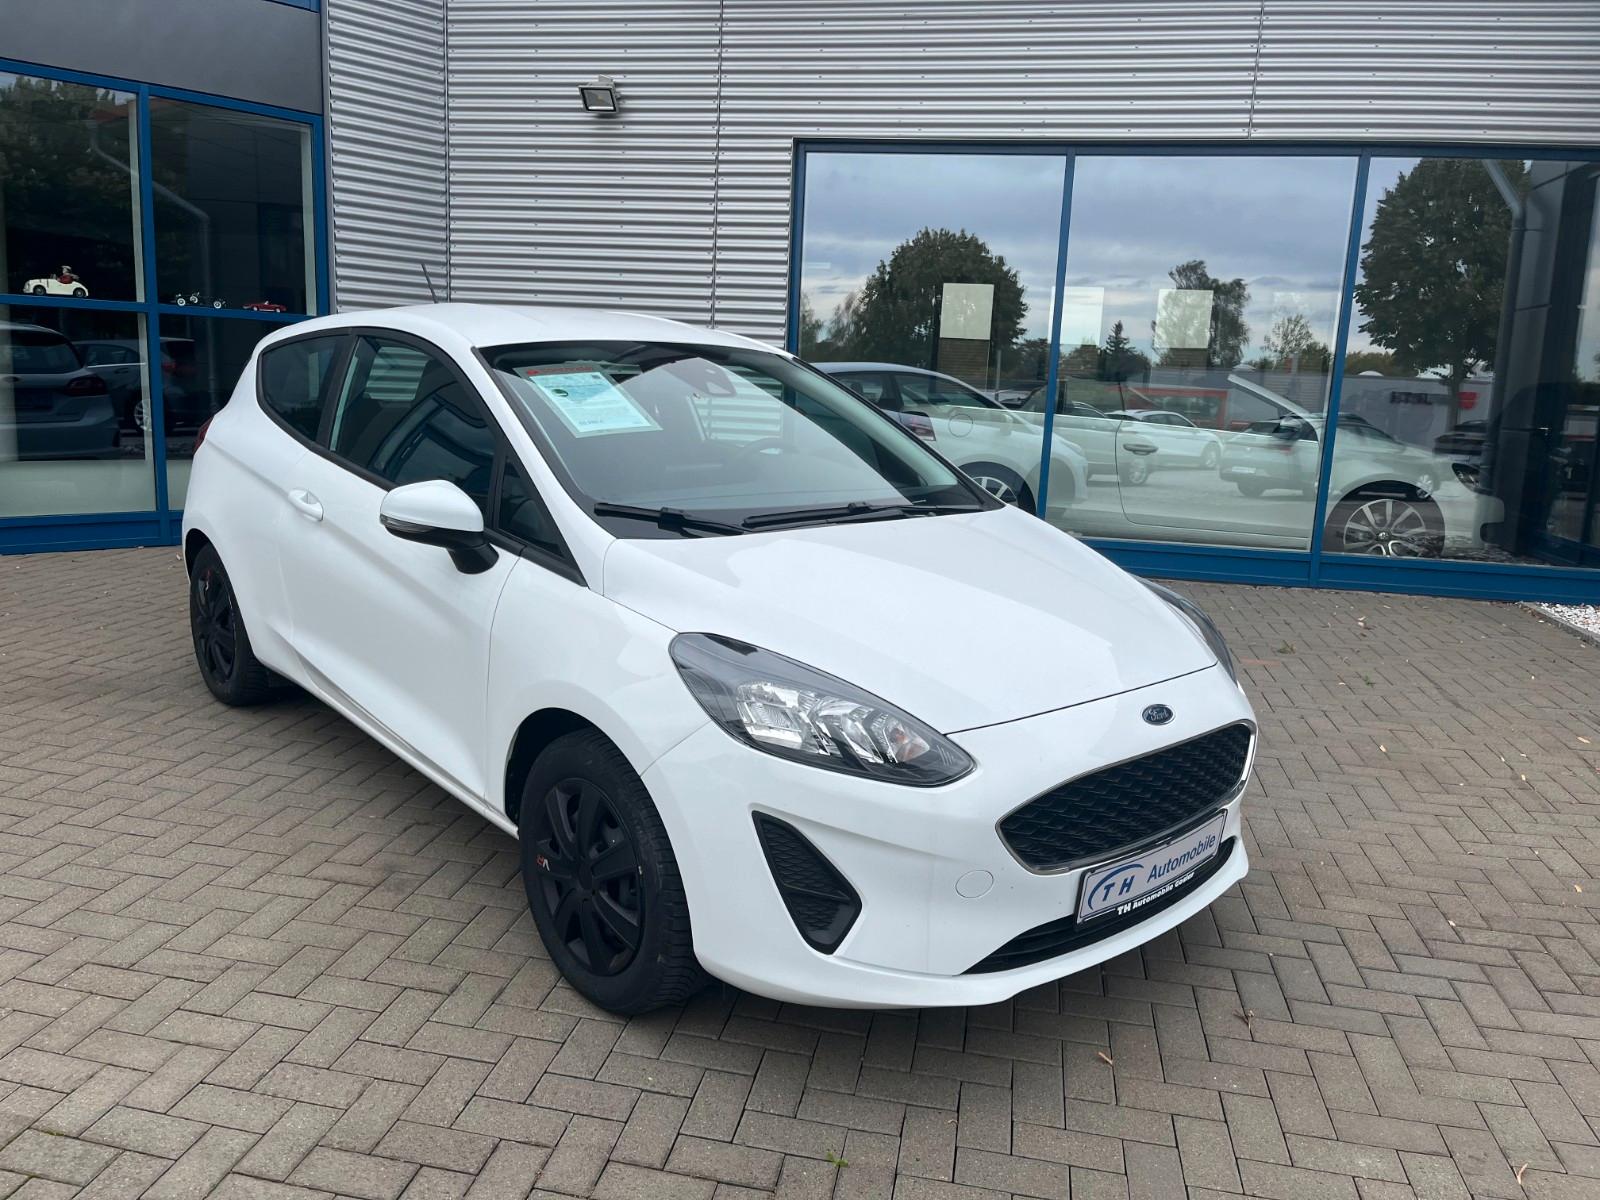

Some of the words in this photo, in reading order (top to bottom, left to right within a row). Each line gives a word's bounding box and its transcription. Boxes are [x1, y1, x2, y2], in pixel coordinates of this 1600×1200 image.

[1146, 708, 1170, 721] Ford
[1147, 836, 1216, 883] Automobile
[1117, 903, 1132, 916] TH
[1133, 885, 1173, 909] Automobile
